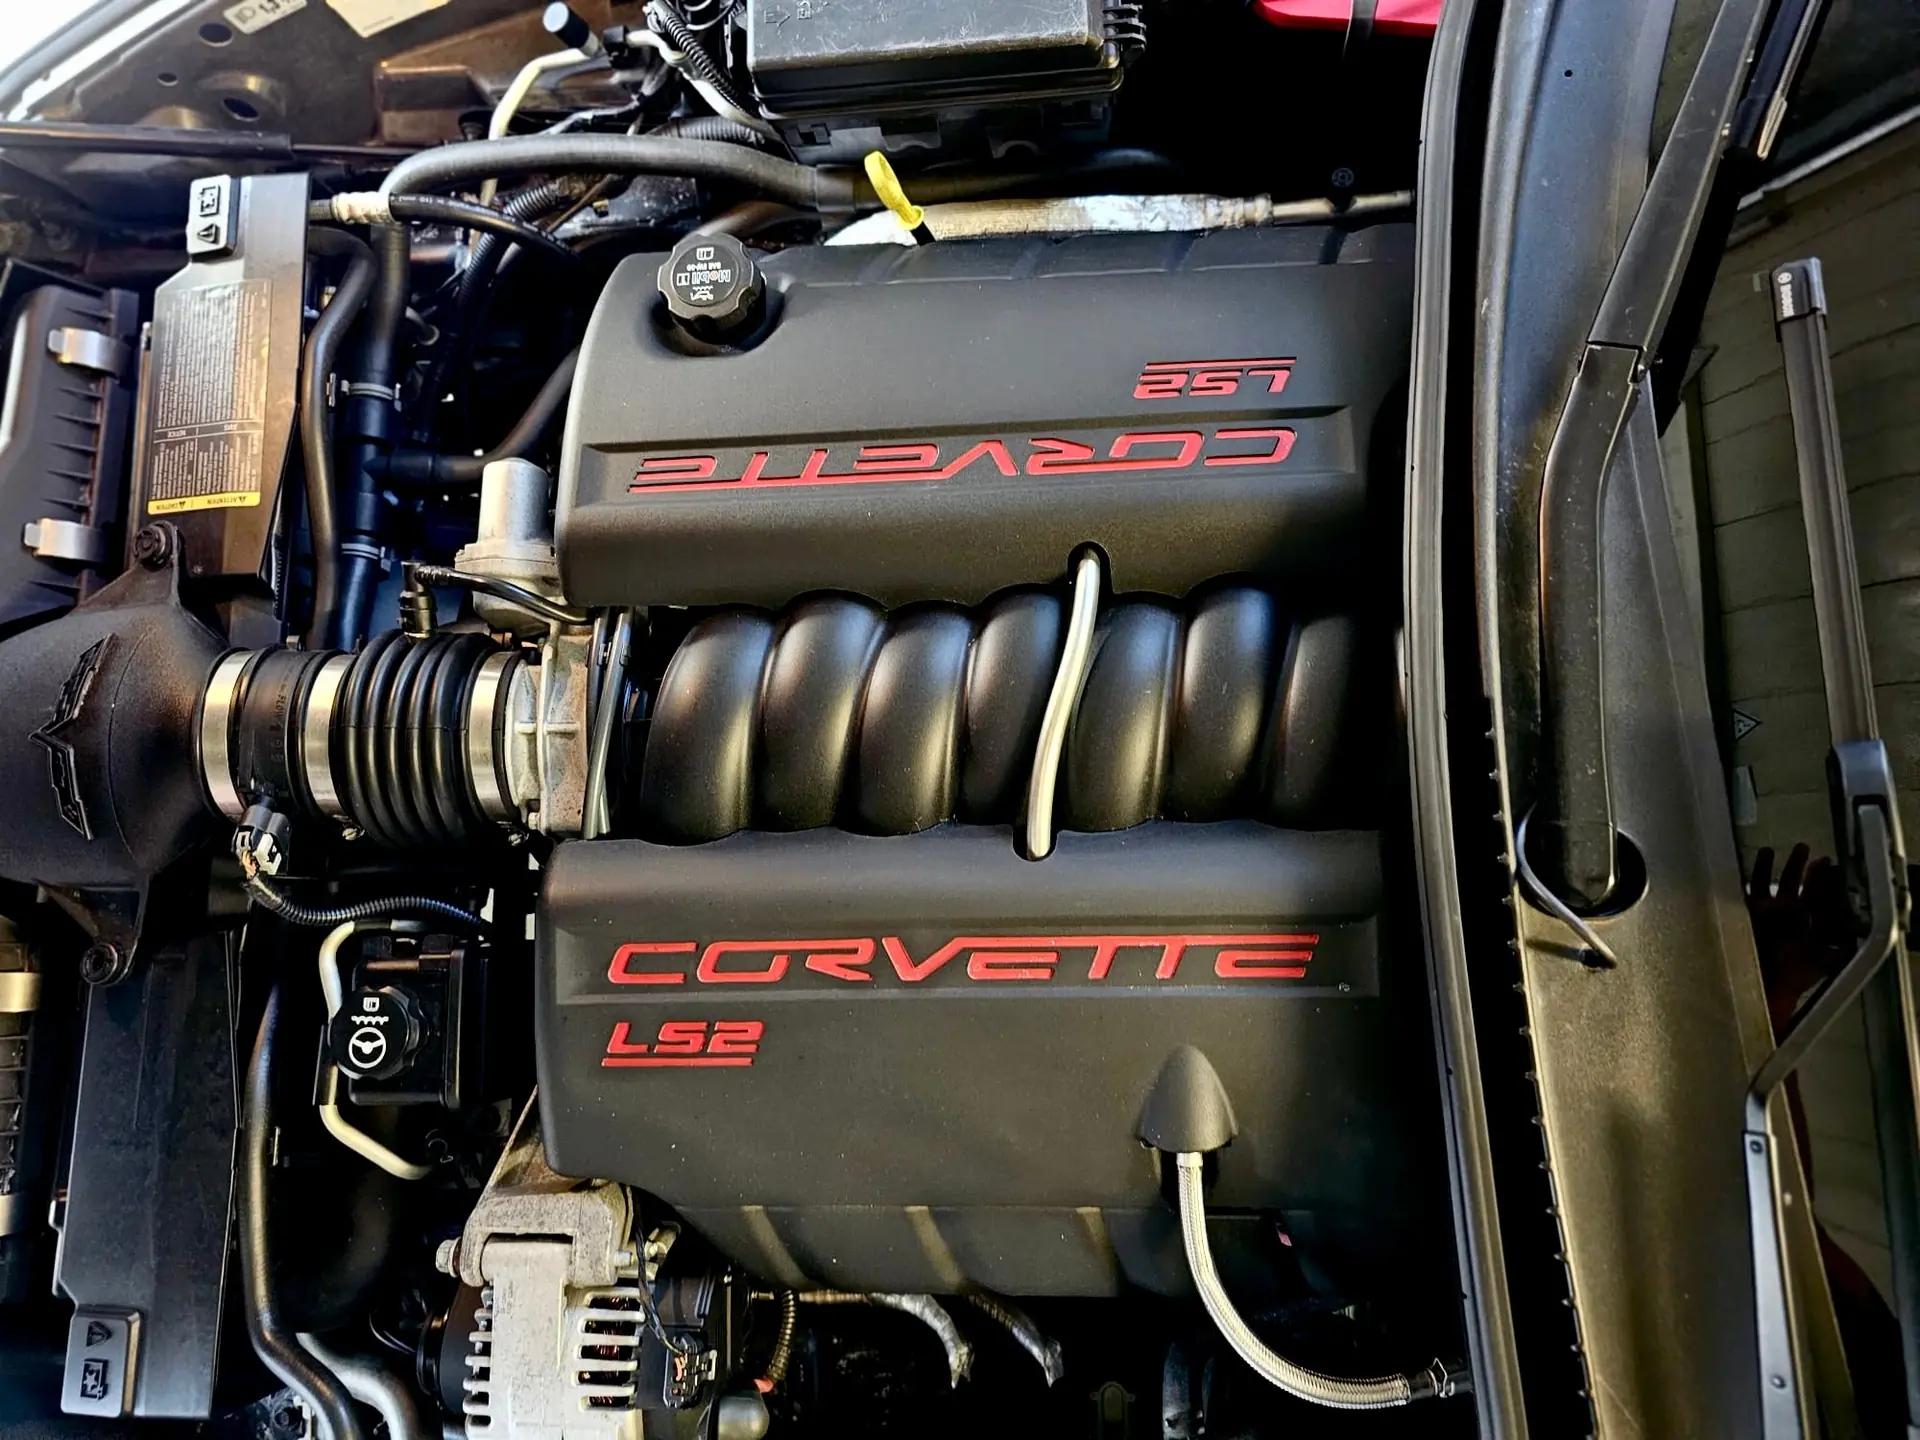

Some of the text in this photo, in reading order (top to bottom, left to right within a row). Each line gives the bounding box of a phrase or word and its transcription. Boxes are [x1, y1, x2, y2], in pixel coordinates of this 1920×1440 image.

[692, 269, 731, 285] Mobil
[1133, 367, 1290, 400] LS2
[167, 430, 187, 438] NOTICE
[628, 427, 1298, 494] CORVETTE
[156, 502, 179, 510] CAUTION
[207, 495, 237, 505] ATTENTION
[606, 933, 1321, 984] CORVETTE
[605, 1020, 765, 1054] LS2
